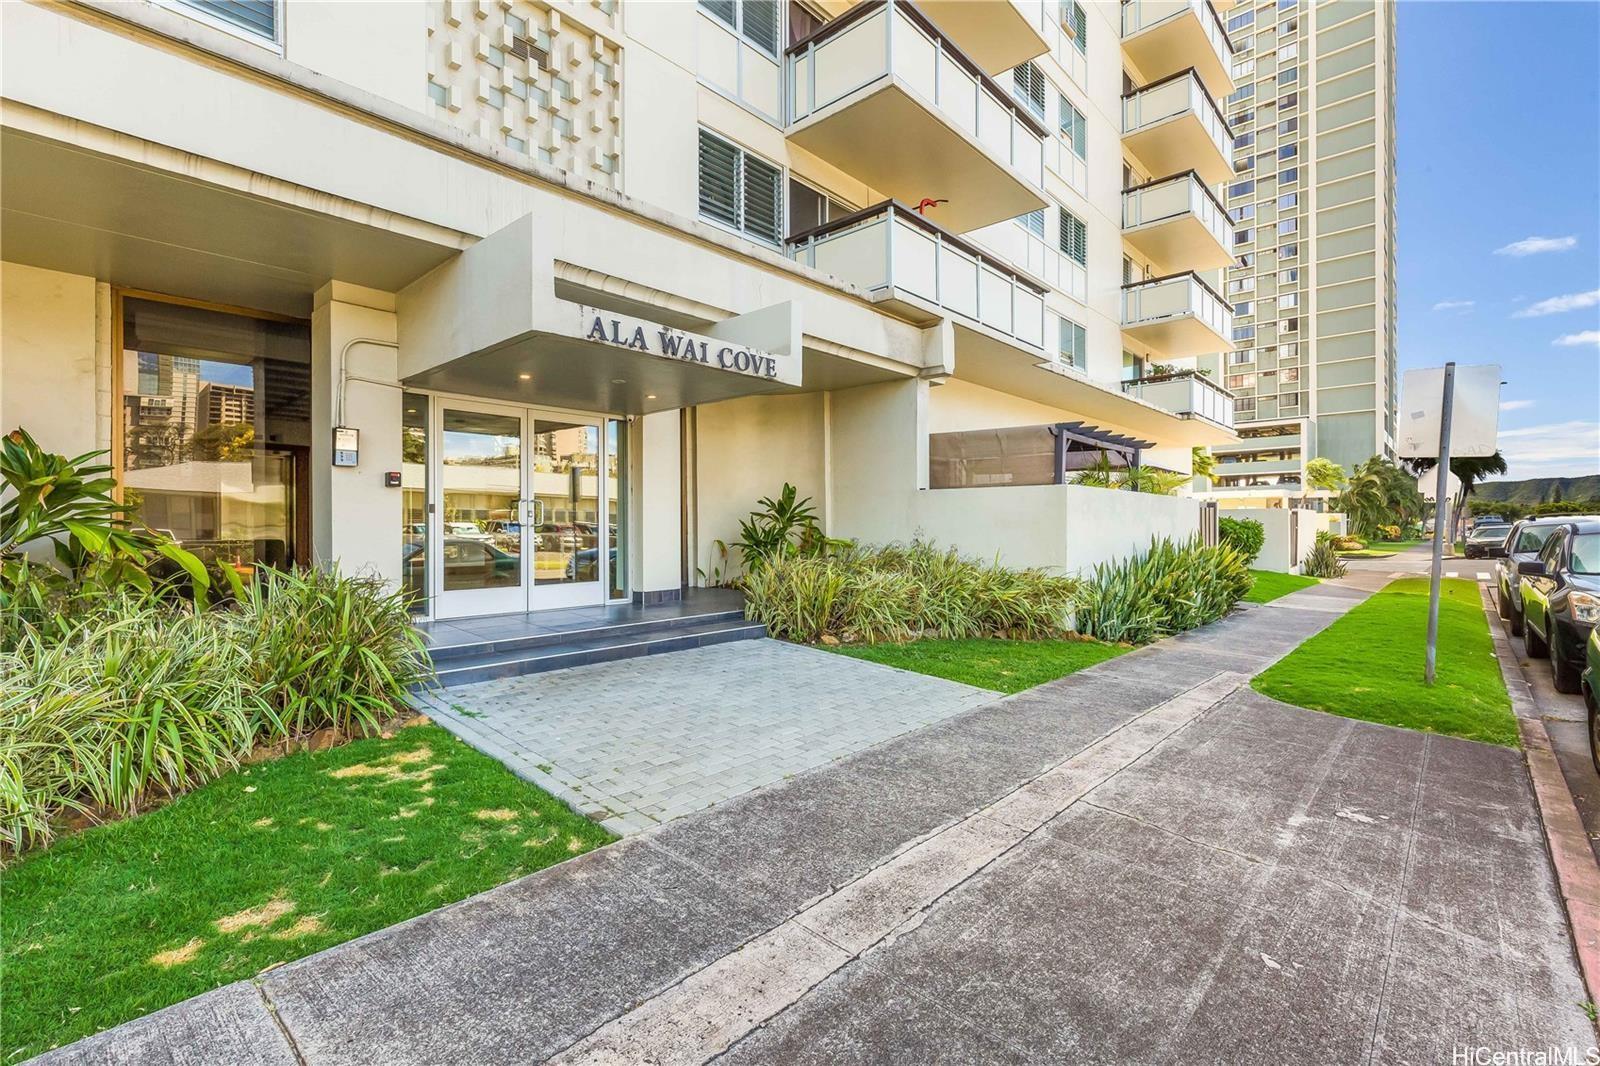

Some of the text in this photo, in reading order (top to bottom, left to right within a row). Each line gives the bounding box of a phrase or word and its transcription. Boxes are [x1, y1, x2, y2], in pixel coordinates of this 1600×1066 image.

[587, 316, 777, 377] ALA WAI COVE
